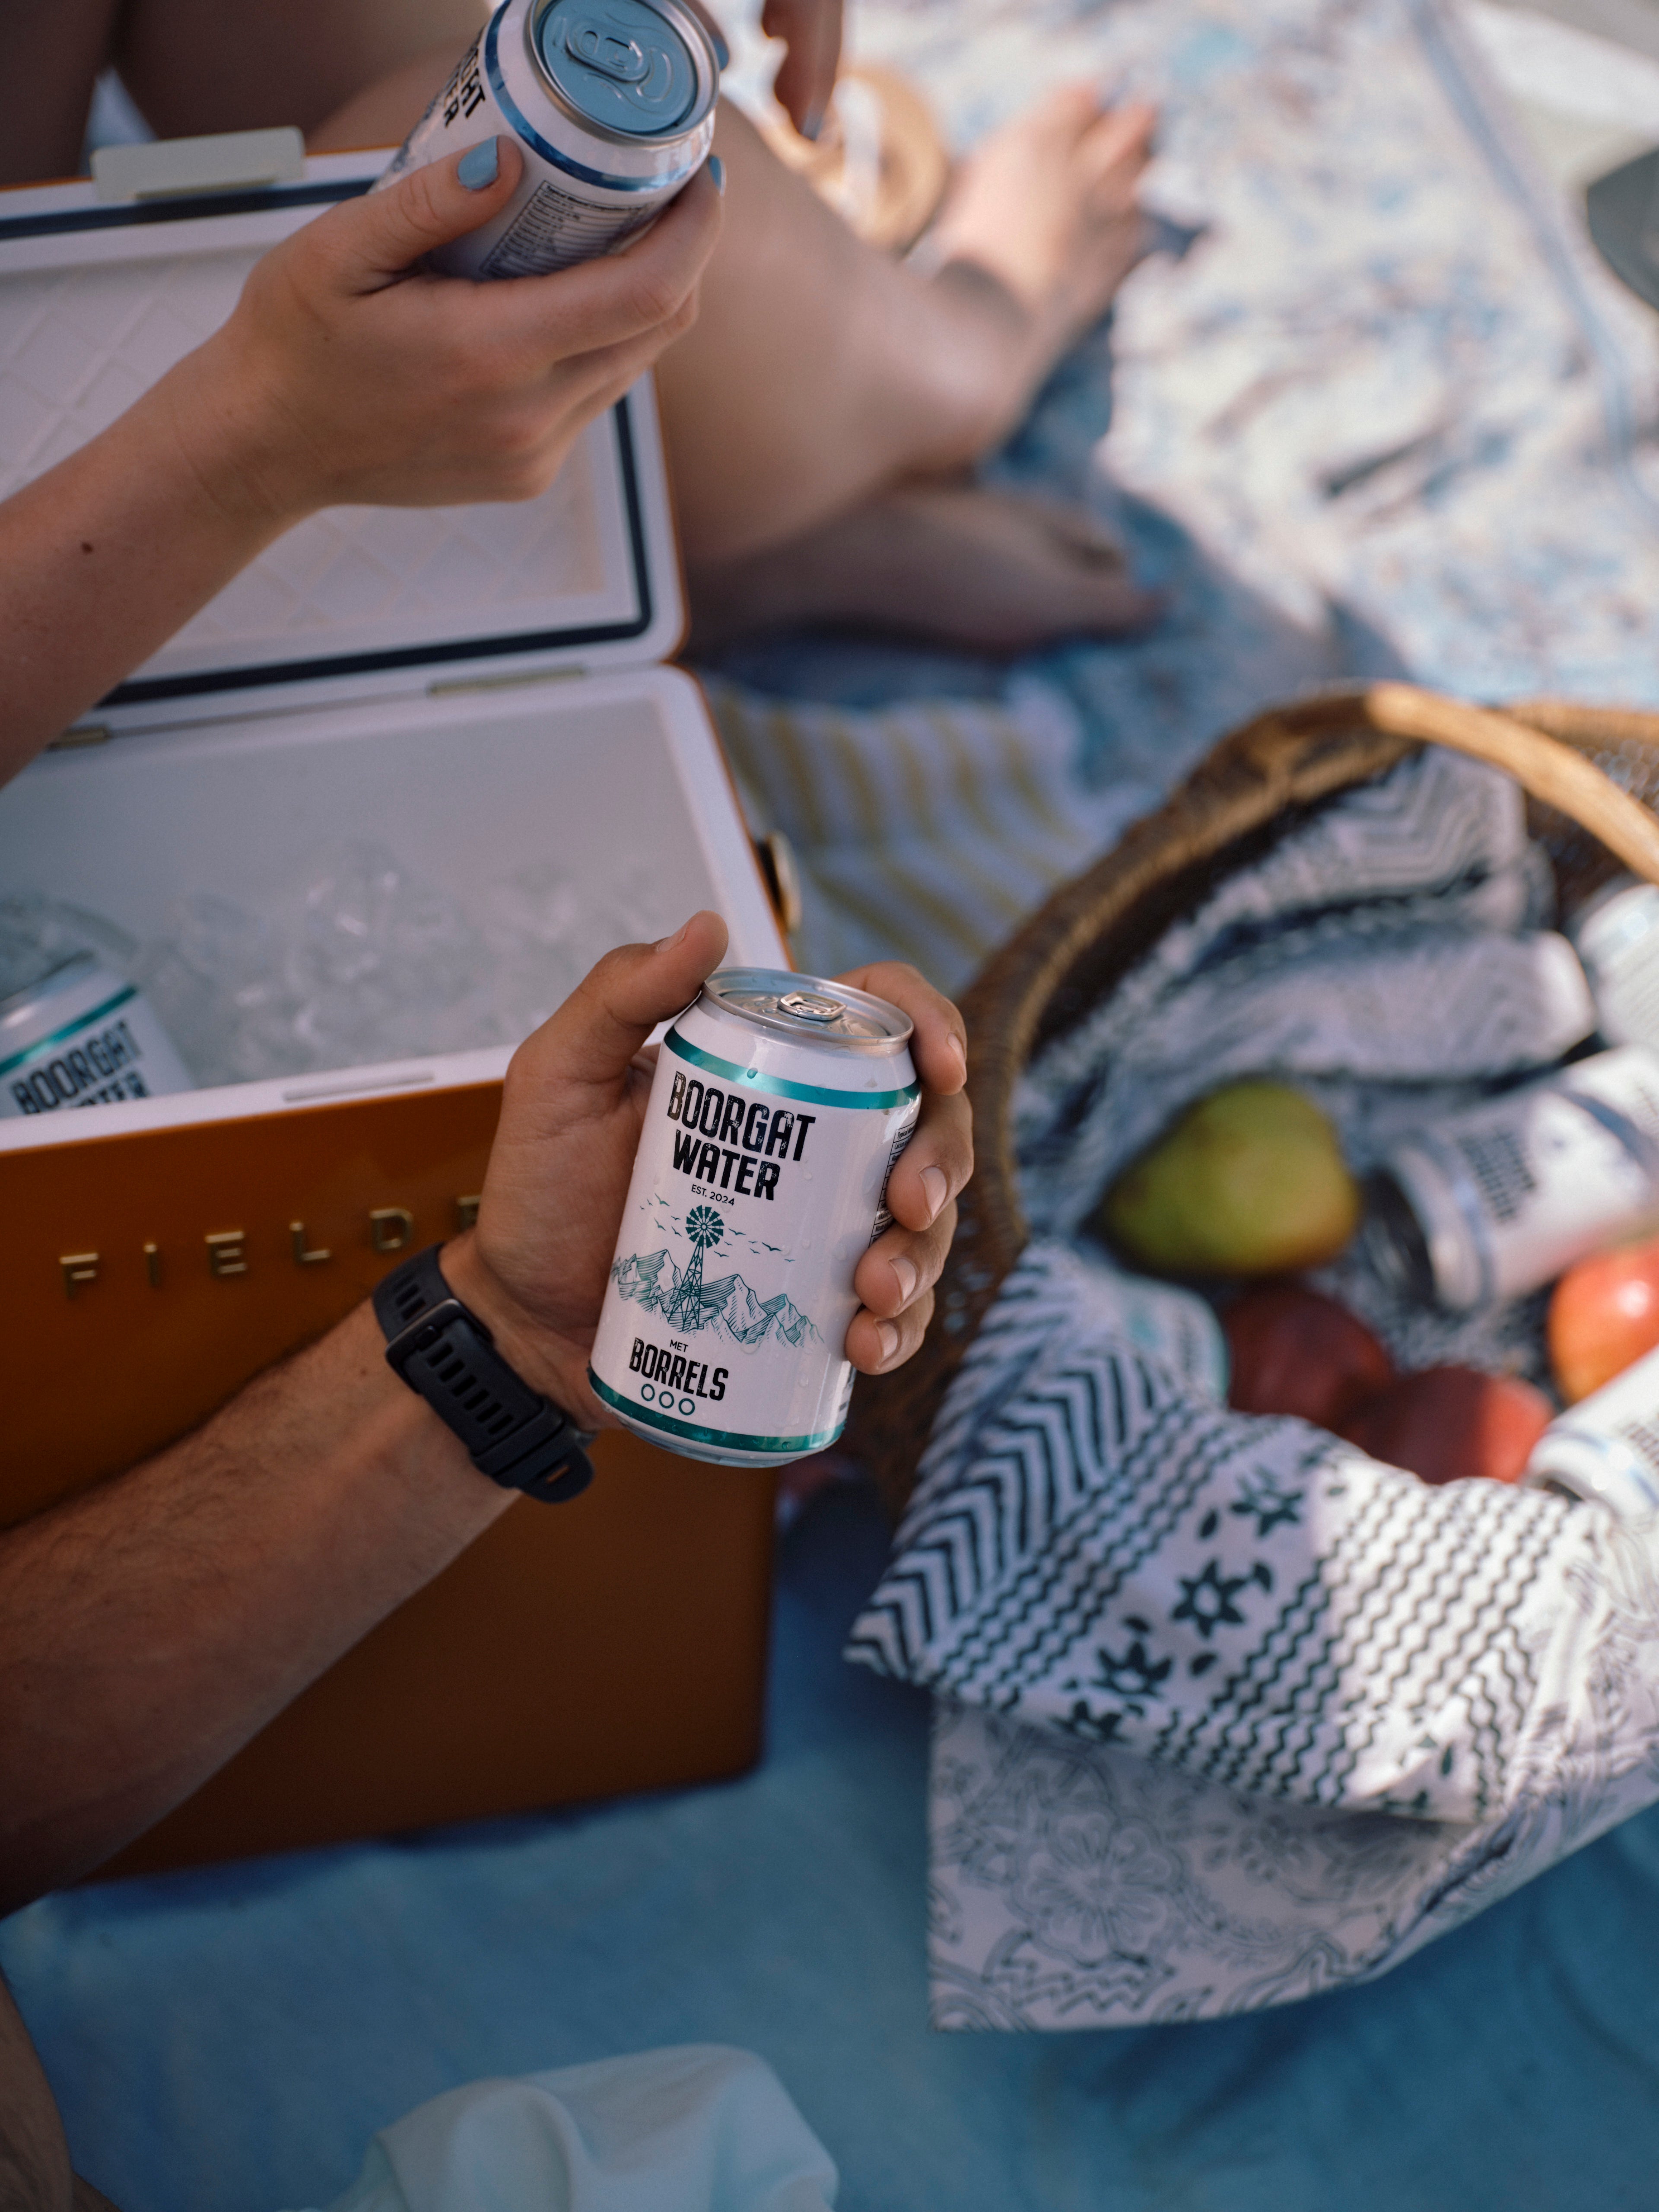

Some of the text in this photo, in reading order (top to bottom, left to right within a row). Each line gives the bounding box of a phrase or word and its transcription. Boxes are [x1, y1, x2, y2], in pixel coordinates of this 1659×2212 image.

[667, 1071, 816, 1162] BOORGAT
[672, 1128, 781, 1201] WATER
[691, 1184, 734, 1206] EST. 2024
[629, 1337, 729, 1402] BORRELS
[670, 1339, 689, 1353] MET
